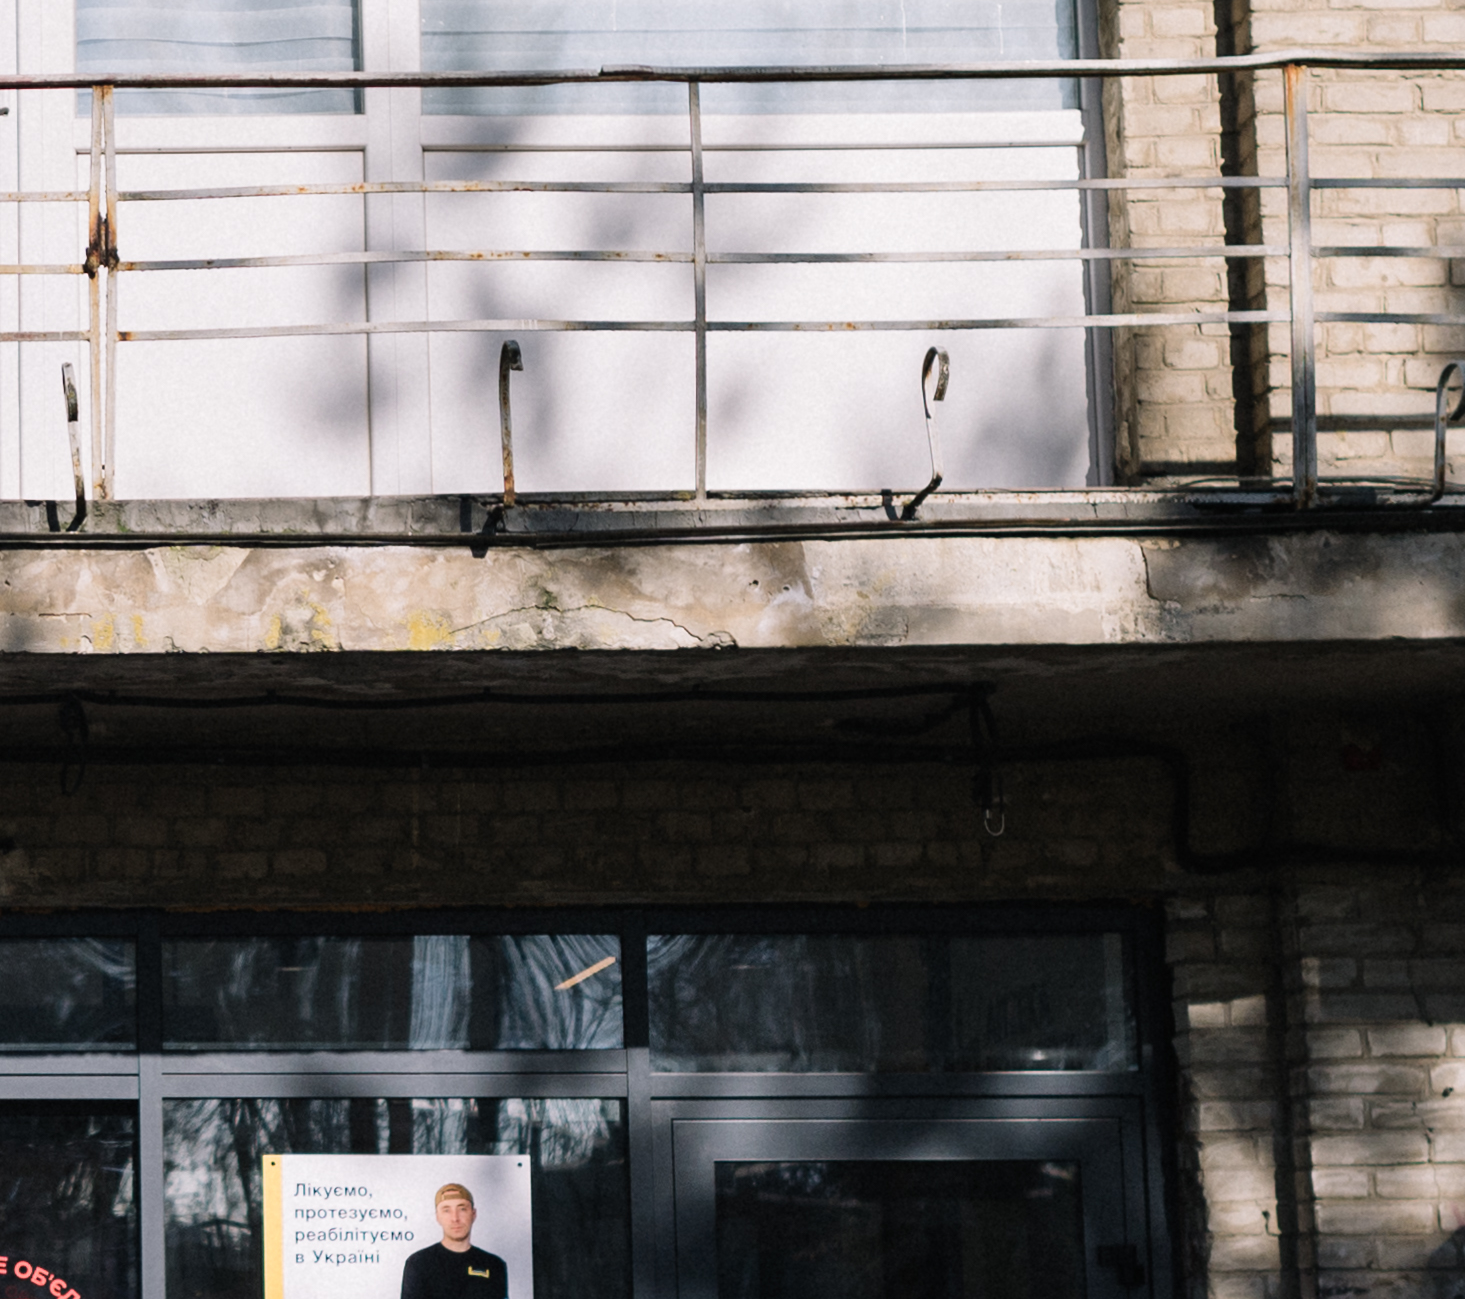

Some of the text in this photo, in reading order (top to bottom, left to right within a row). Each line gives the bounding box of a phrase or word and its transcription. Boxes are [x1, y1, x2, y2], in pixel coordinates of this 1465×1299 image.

[293, 1182, 373, 1199] Лікуємо,
[294, 1208, 409, 1222] протезуємо,
[294, 1229, 415, 1244] реабілітуємо
[295, 1250, 380, 1267] в Україні
